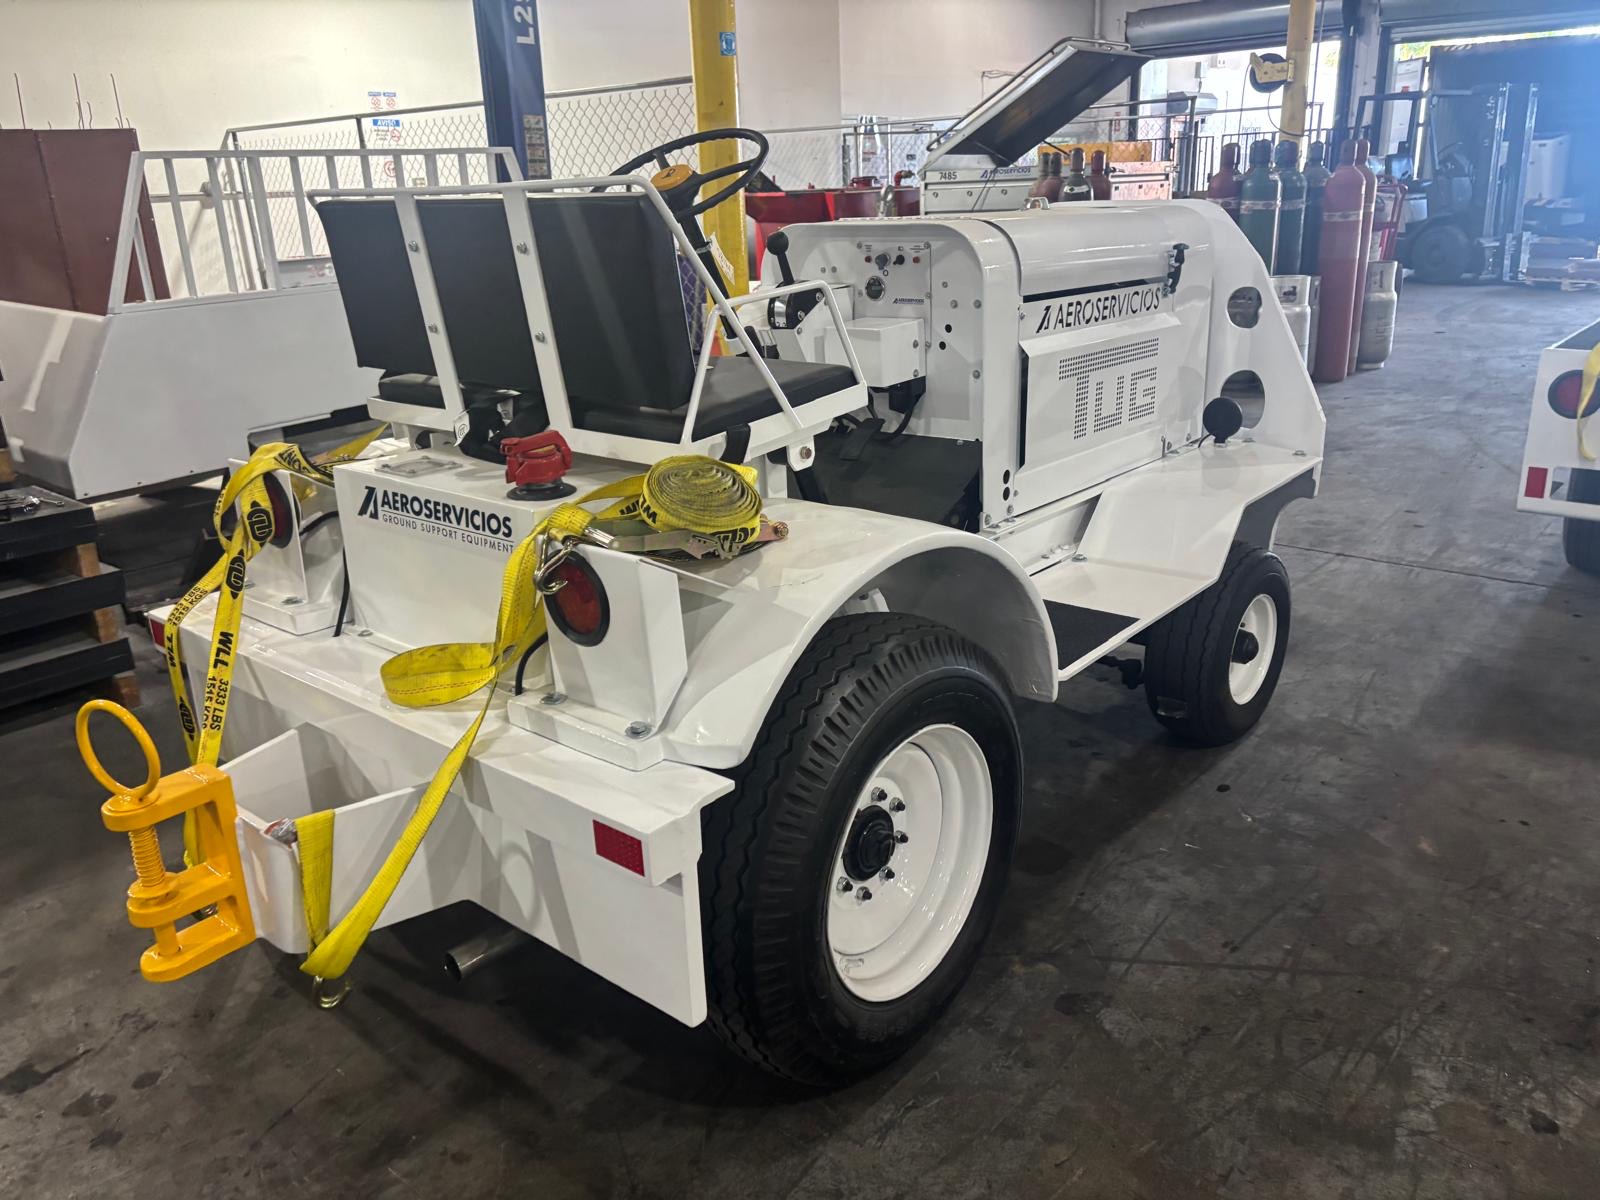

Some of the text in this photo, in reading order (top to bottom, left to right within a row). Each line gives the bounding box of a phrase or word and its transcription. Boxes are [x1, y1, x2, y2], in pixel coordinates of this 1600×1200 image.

[513, 0, 537, 45] L2
[939, 172, 958, 181] 7485
[1054, 286, 1161, 331] AEROSERVICIOS
[1058, 337, 1159, 440] TUG
[381, 490, 512, 538] AEROSERVICIOS
[382, 513, 514, 554] GROUND SUPPORT EQUIPMENT
[189, 589, 208, 606] KGS
[166, 586, 201, 668] WLL 3333 LBS
[209, 631, 234, 731] WLL 3333 LBS
